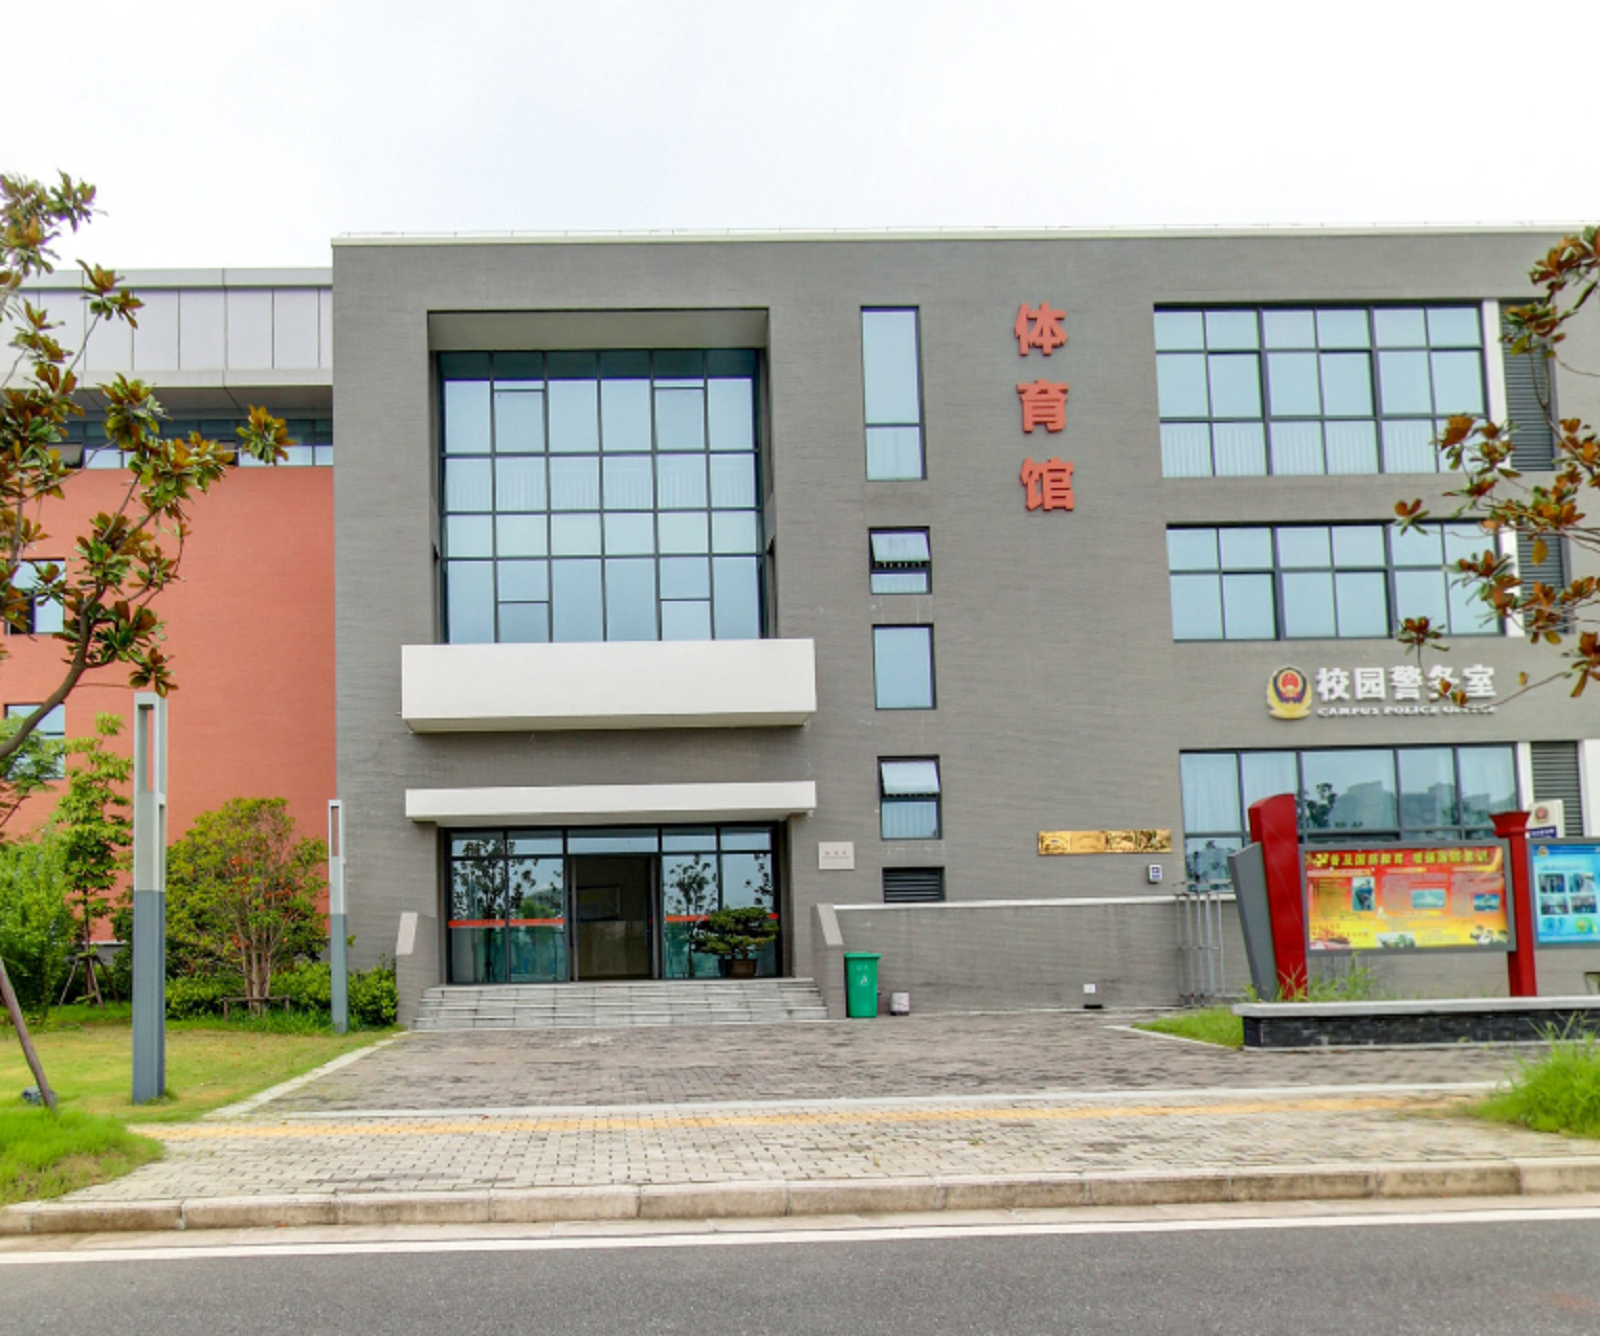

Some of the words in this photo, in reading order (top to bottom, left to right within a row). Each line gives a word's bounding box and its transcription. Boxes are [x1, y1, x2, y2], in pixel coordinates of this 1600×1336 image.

[1014, 302, 1075, 512] 体育馆
[1316, 664, 1497, 701] 校园警务室
[1317, 706, 1379, 717] CAMPUS
[1383, 704, 1440, 716] POLICE
